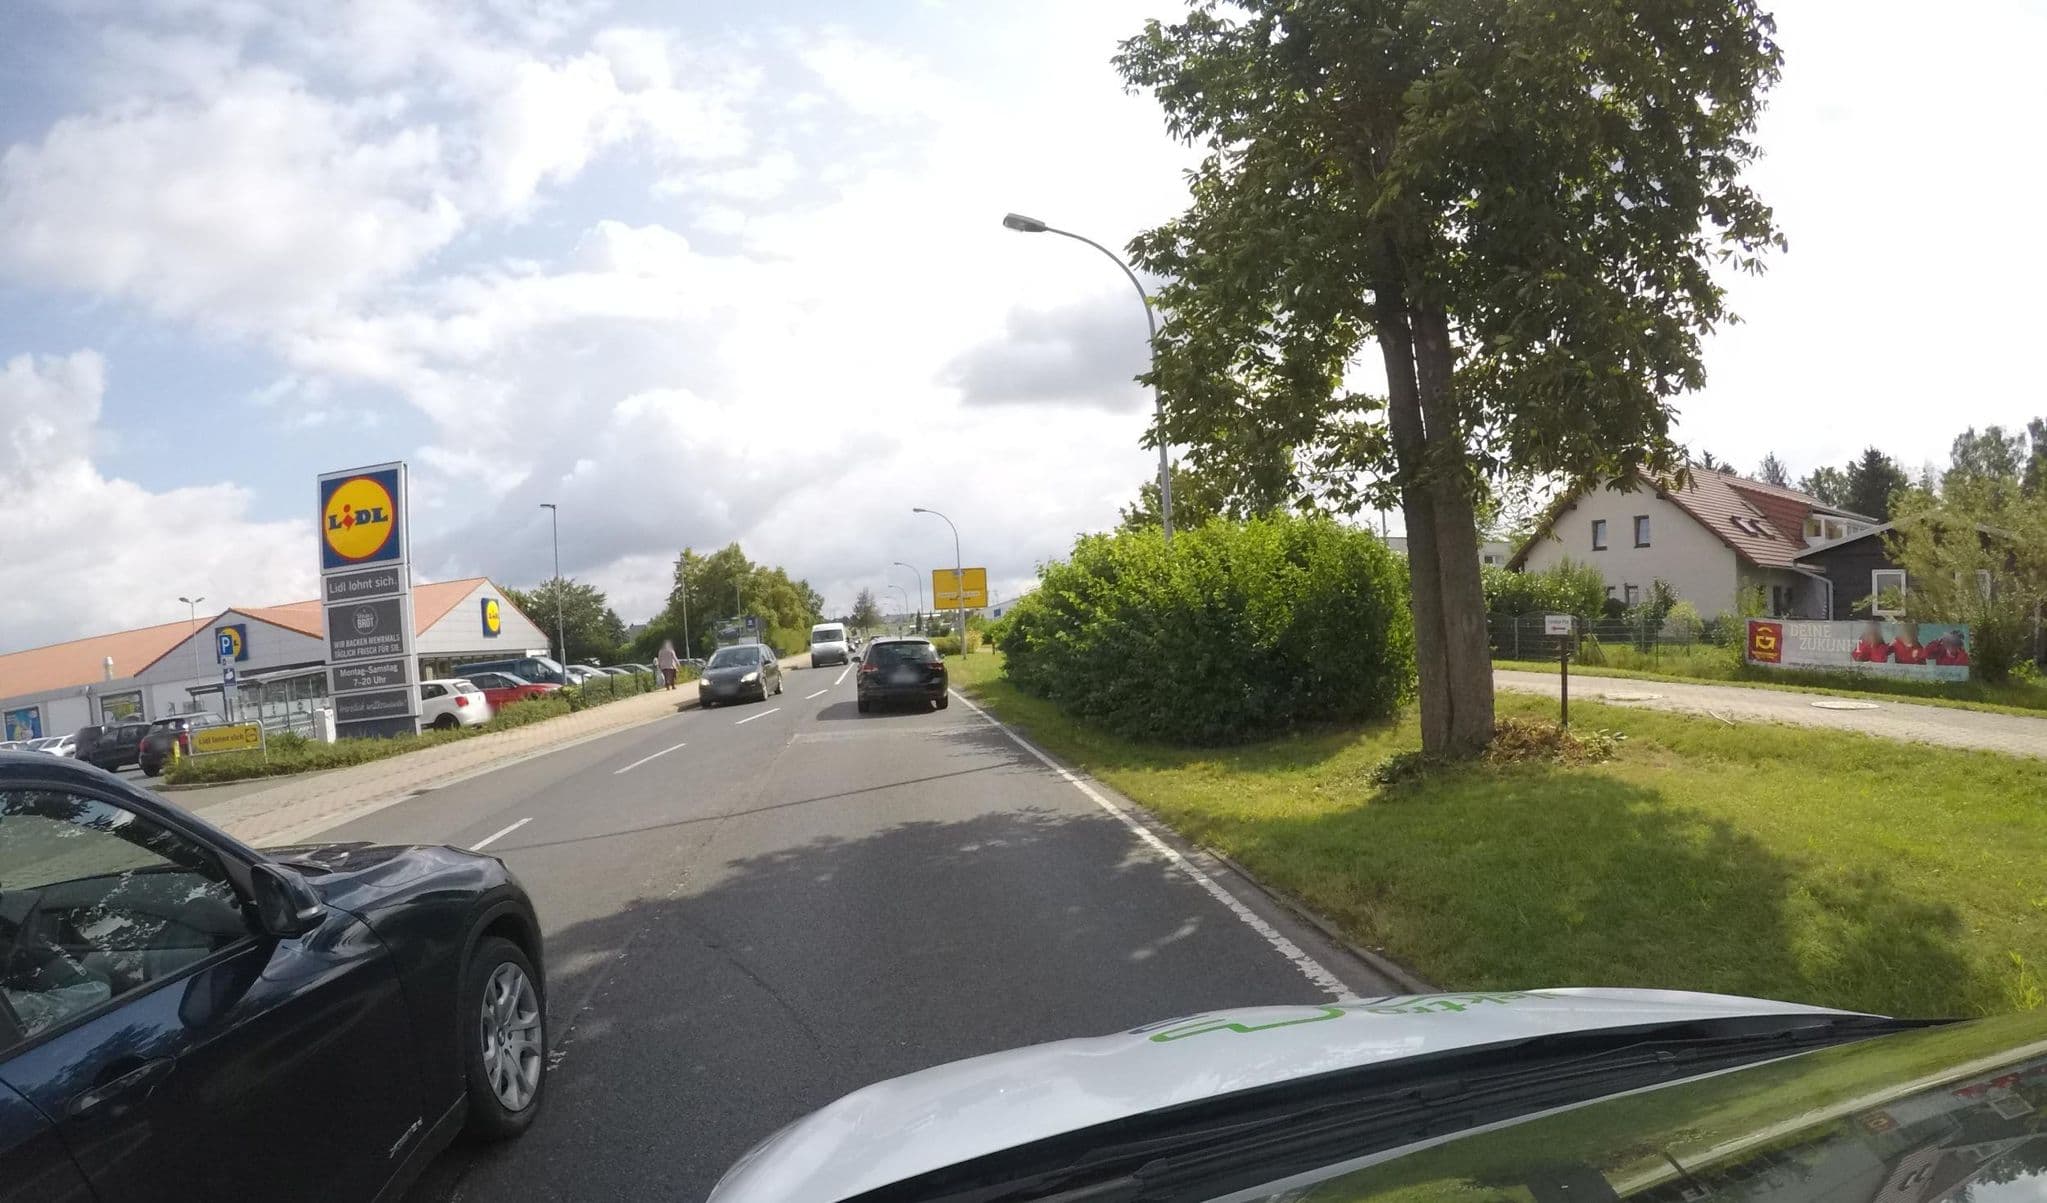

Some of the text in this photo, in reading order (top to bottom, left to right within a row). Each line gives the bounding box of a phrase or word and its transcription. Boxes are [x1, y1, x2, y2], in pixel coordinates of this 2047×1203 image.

[329, 582, 346, 594] Lidl
[348, 578, 373, 592] lohnt
[1790, 623, 1832, 638] DEINE
